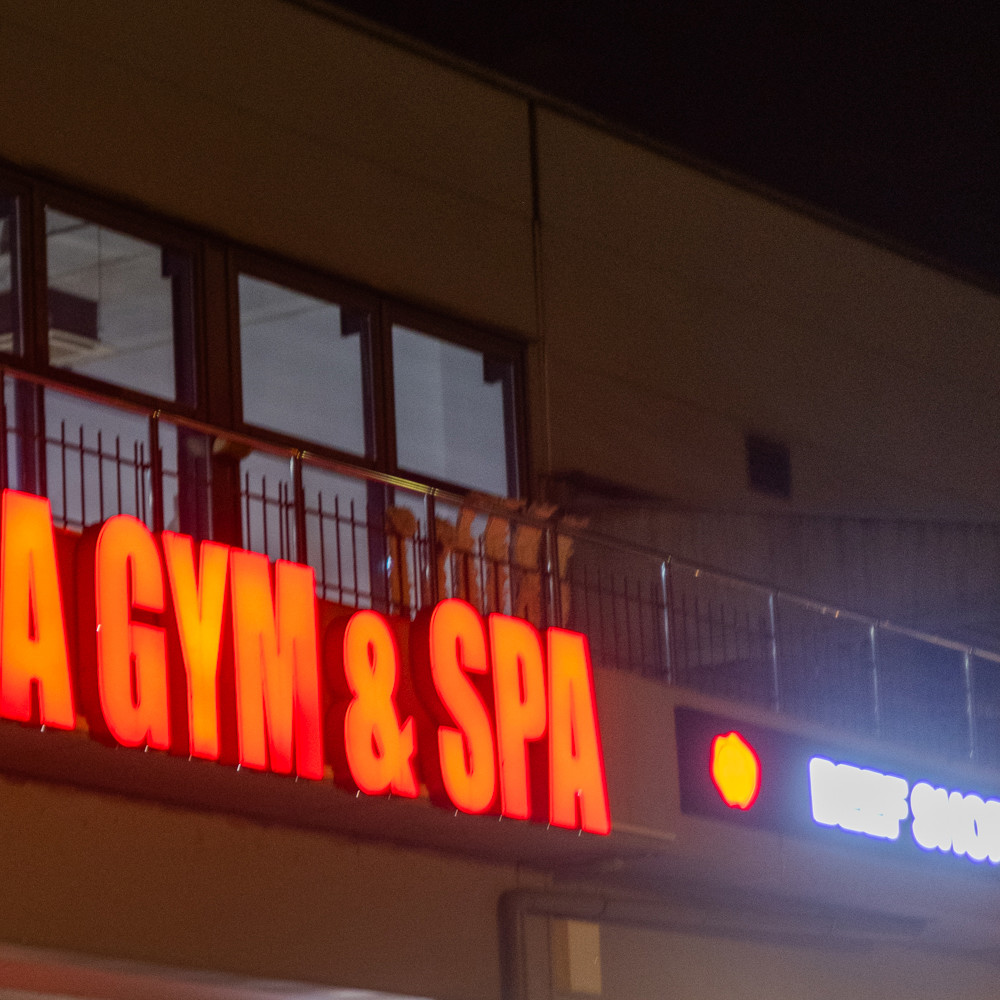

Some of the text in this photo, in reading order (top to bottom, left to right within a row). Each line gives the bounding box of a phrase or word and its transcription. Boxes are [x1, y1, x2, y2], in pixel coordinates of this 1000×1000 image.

[95, 513, 324, 781] GYM
[343, 609, 420, 799] &
[428, 597, 612, 836] SPA
